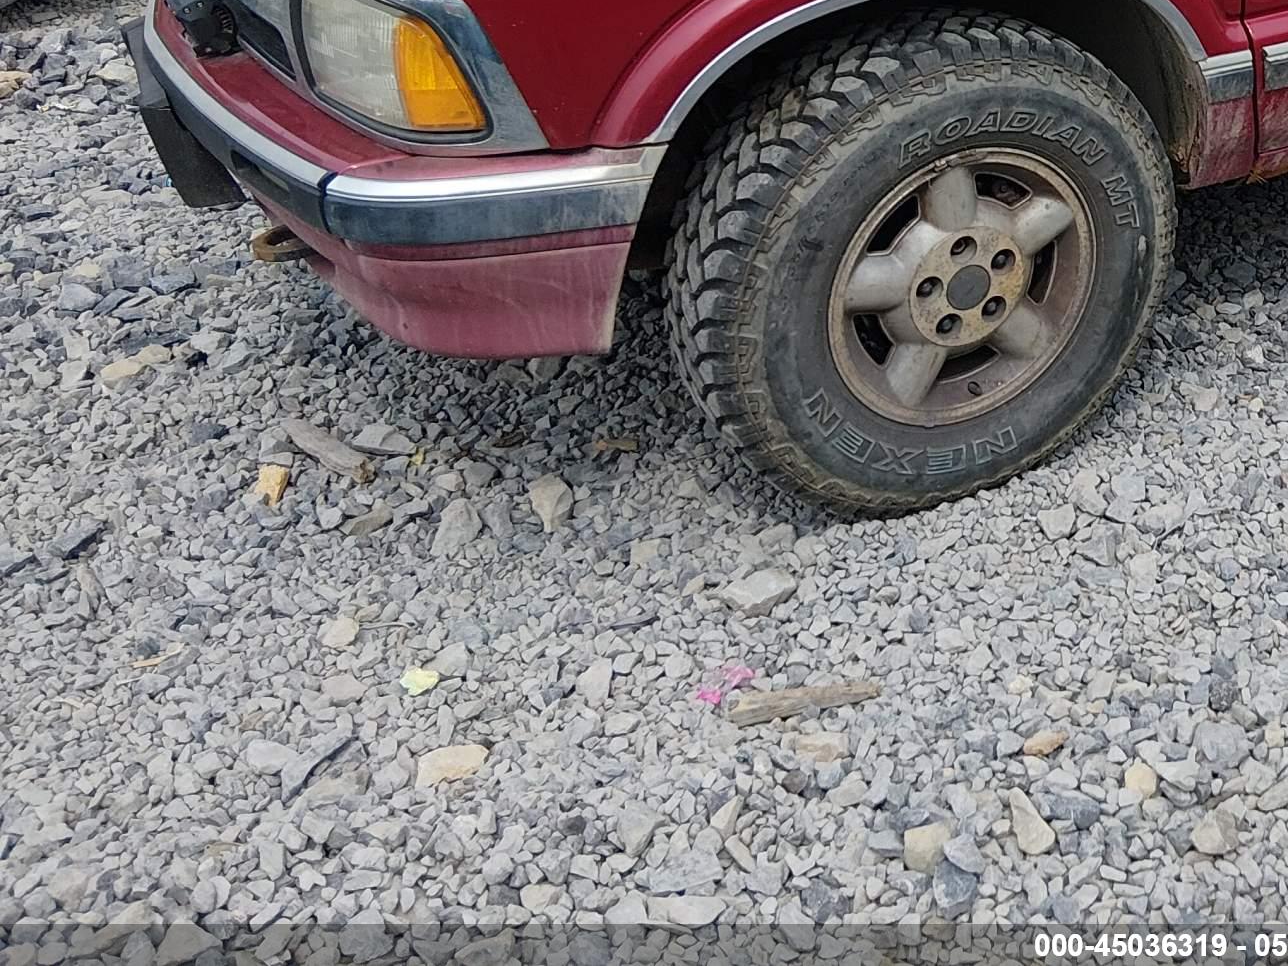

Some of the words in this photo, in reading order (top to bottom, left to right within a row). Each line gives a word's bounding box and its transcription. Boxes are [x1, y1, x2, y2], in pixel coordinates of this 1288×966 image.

[898, 109, 1109, 170] ROADIAN
[1101, 173, 1141, 229] MT
[803, 387, 1019, 476] NEXEN
